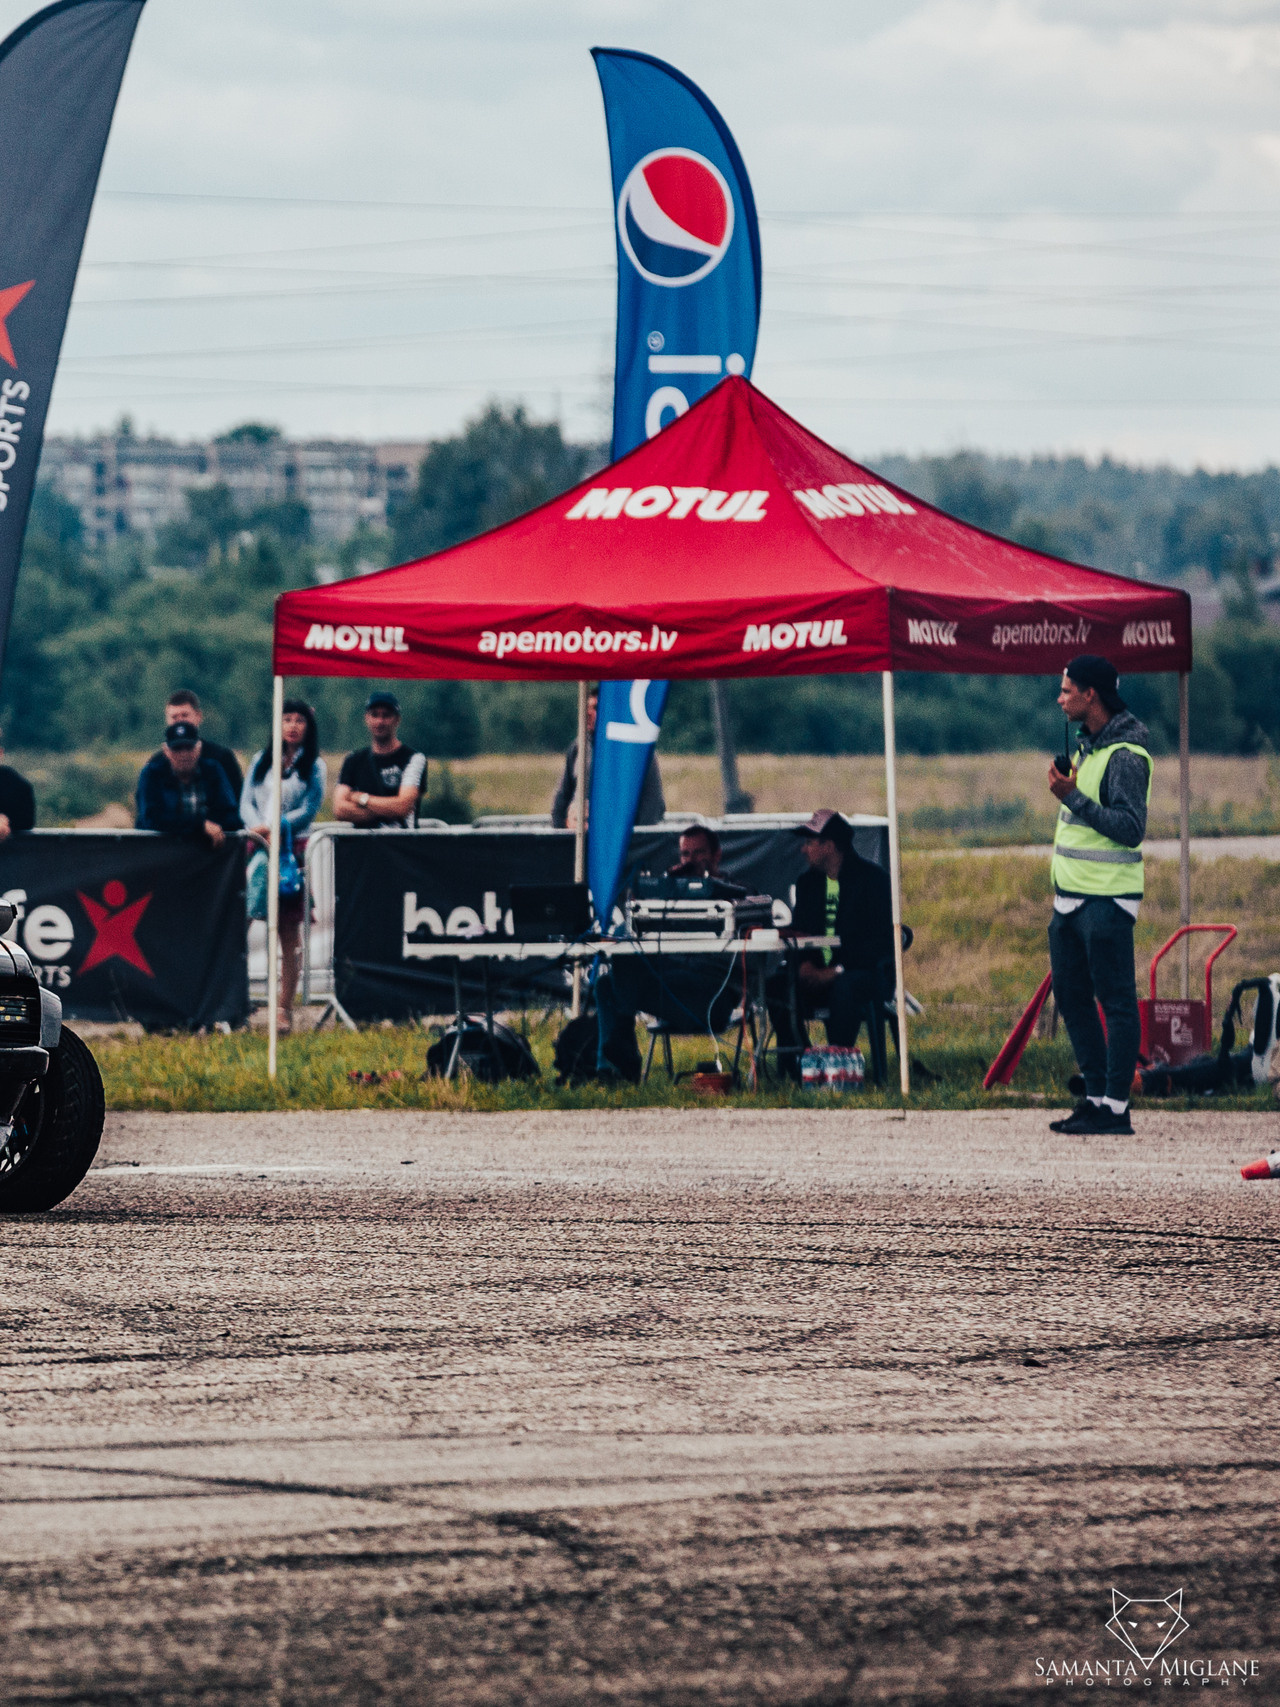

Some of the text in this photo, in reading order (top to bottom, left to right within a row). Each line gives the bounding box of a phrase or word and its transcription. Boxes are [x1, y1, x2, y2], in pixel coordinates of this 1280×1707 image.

[565, 485, 770, 522] MOTUL
[792, 483, 918, 521] MOTUL
[304, 619, 848, 659] MOTUL apemotors.lv MOTUL
[907, 617, 1176, 651] MOTUL apemotors.lv MOTUL
